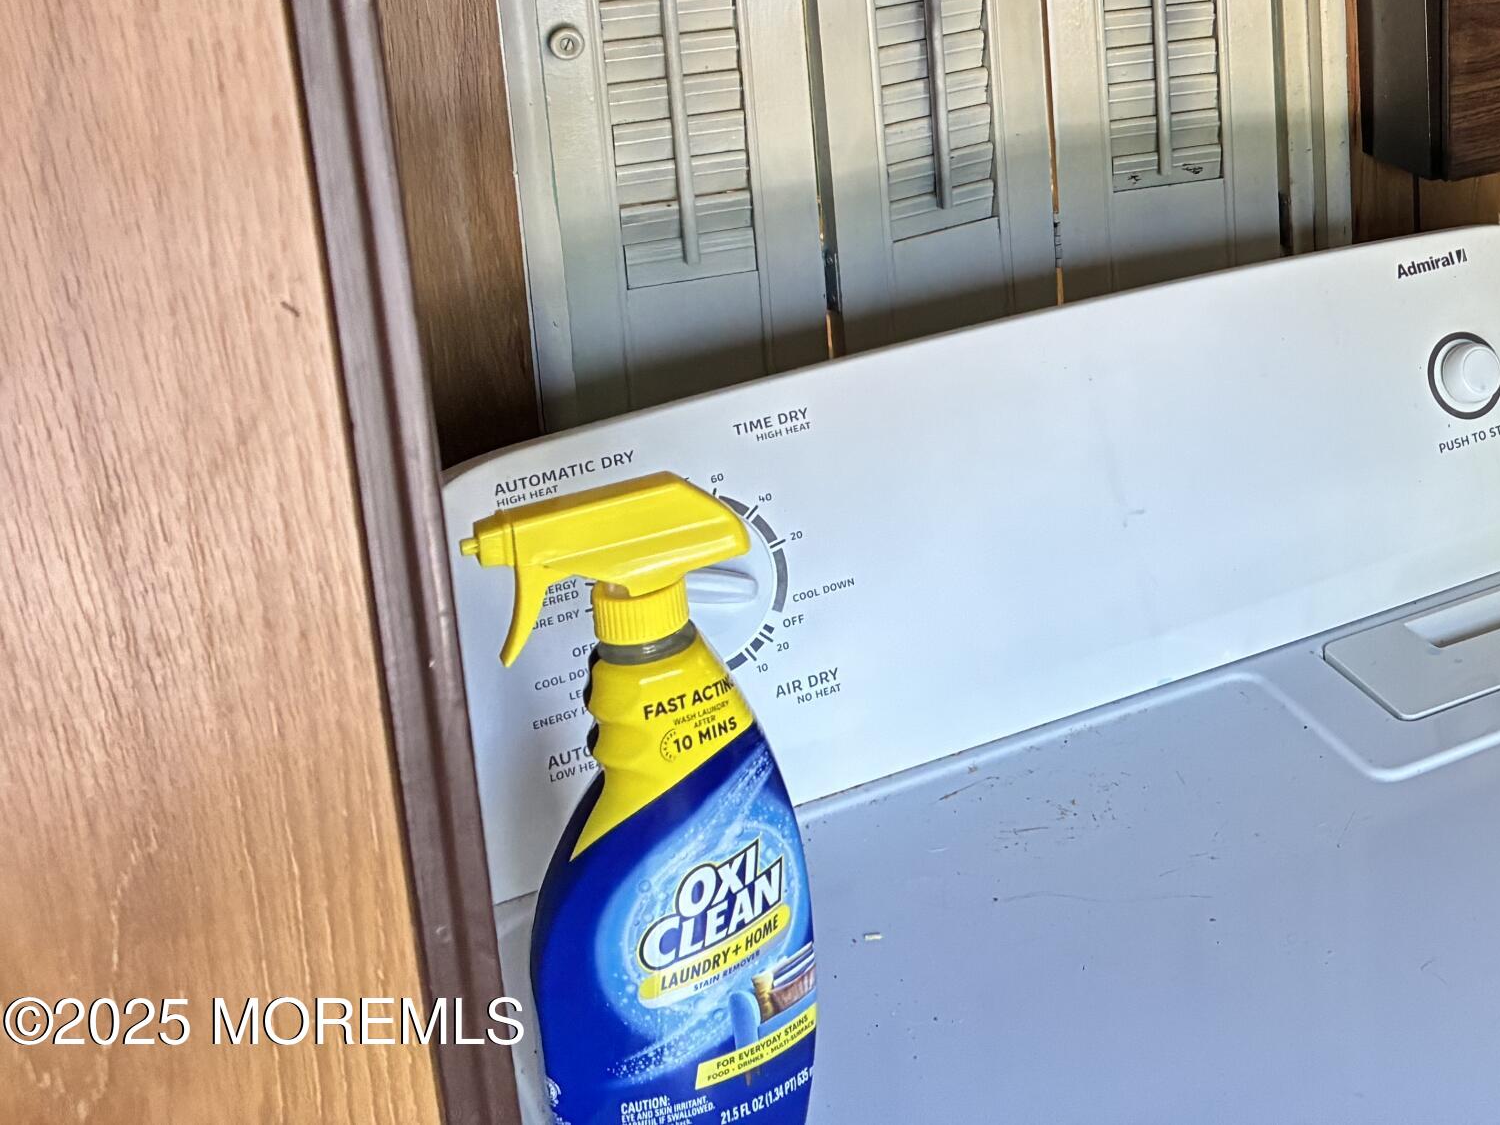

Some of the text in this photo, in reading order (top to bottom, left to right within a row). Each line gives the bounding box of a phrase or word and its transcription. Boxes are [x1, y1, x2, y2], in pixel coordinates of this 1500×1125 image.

[1397, 252, 1455, 279] Admiral
[733, 407, 808, 436] TIME DRY
[756, 422, 811, 442] HIGH HEAT
[1438, 435, 1470, 453] PUSH
[1471, 430, 1487, 444] TO
[494, 449, 635, 496] AUTOMATIC DRY
[710, 473, 724, 484] 60
[496, 484, 558, 508] HIGH HEAT
[758, 493, 772, 502] 40
[790, 530, 803, 541] 20
[542, 590, 579, 607] ERRED
[545, 579, 577, 595] ERGY
[792, 577, 855, 603] COOL DOWN
[557, 609, 580, 623] DRY
[782, 614, 805, 628] OFF
[776, 641, 789, 652] 20
[534, 668, 589, 691] COOL DO
[756, 663, 769, 673] 10
[775, 667, 838, 699] AIR DRY
[796, 683, 841, 704] NO HEAT
[643, 674, 735, 720] FAST ACTIN
[532, 707, 578, 730] ENERGY
[673, 699, 730, 726] WASH LAUNDRY
[694, 715, 717, 728] AFTER
[673, 716, 738, 753] 10 MINS
[549, 766, 576, 783] LOW
[677, 839, 758, 918] OXI
[640, 858, 783, 969] CLEAN
[661, 949, 733, 990] LAUNDRY
[744, 914, 779, 951] HOME
[693, 950, 760, 991] STAIN REMOVER
[716, 1014, 809, 1070] FOR EVERYDAY STAINS
[707, 1068, 730, 1082] FOOD
[737, 1053, 764, 1071] DRINKS
[621, 1095, 670, 1115] CAUTION:
[720, 1107, 739, 1125] 21.5
[740, 1102, 751, 1118] FL
[751, 1095, 764, 1113] OZ
[765, 1084, 784, 1108] (1.34
[784, 1076, 797, 1095] PT)
[797, 1067, 809, 1087] 635
[621, 1113, 636, 1124] EYE
[636, 1110, 653, 1121] AND
[654, 1106, 672, 1118] SKIN
[659, 1115, 666, 1125] IF
